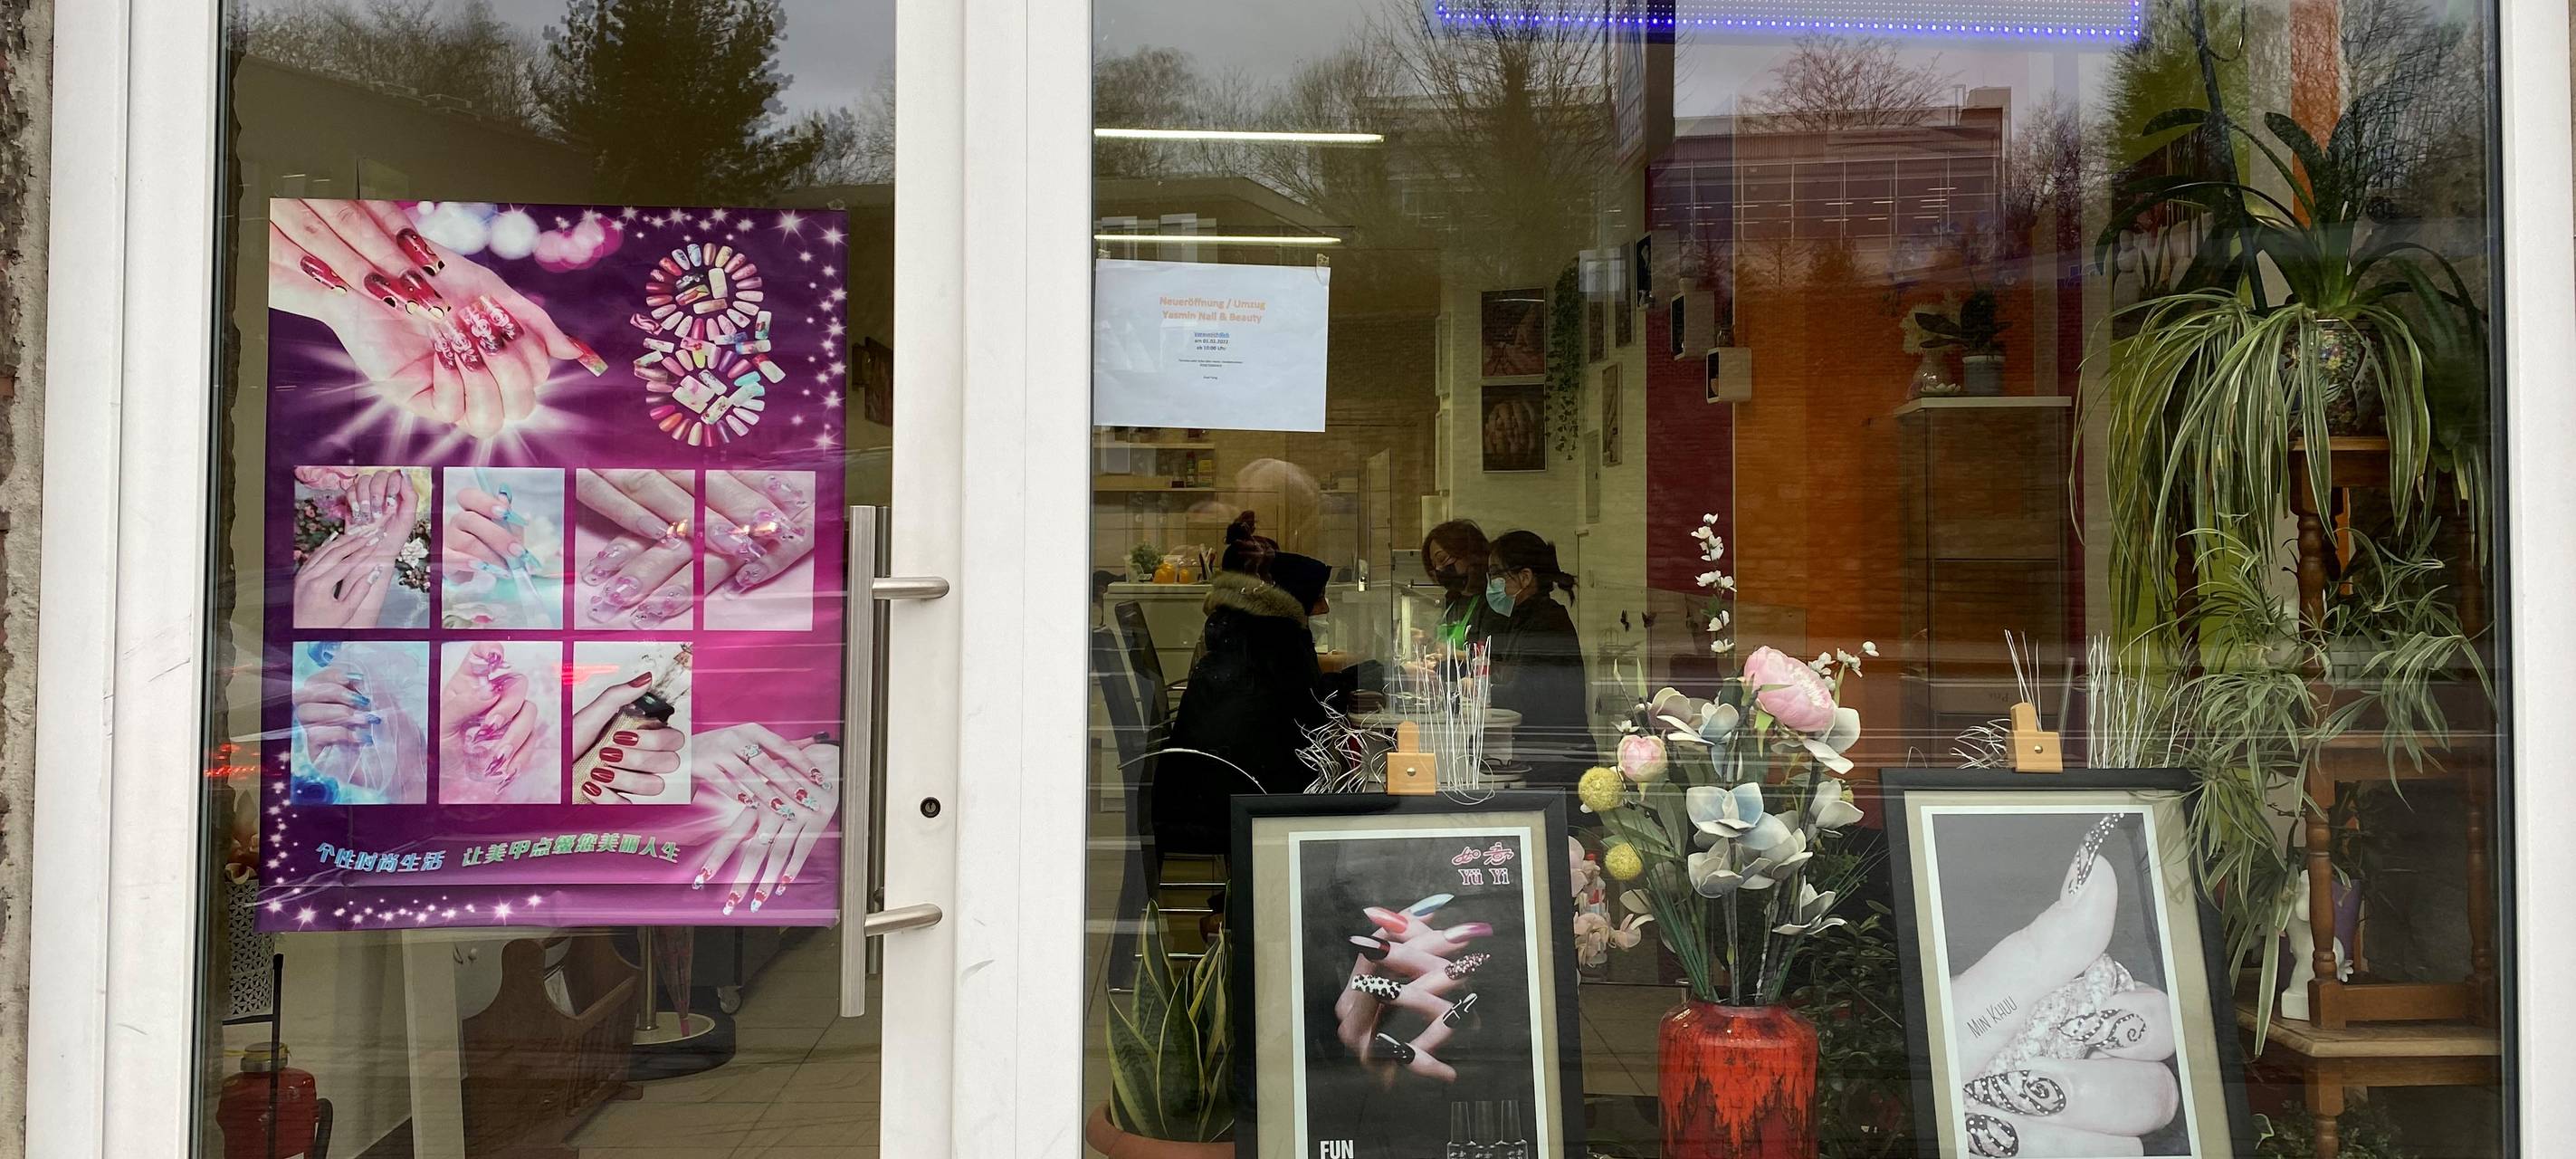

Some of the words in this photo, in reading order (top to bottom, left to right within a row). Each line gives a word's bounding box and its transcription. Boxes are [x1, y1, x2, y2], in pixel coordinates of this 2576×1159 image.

[1159, 296, 1224, 309] Neueröffnung
[1226, 298, 1232, 309] /
[1234, 300, 1265, 311] Umzug
[1162, 310, 1197, 320] Yasmin
[1197, 311, 1217, 321] Nail
[1219, 312, 1227, 321] &
[1229, 312, 1263, 324] Beauty
[315, 841, 446, 874] 个性时尚生活
[1320, 1140, 1355, 1159] FUN
